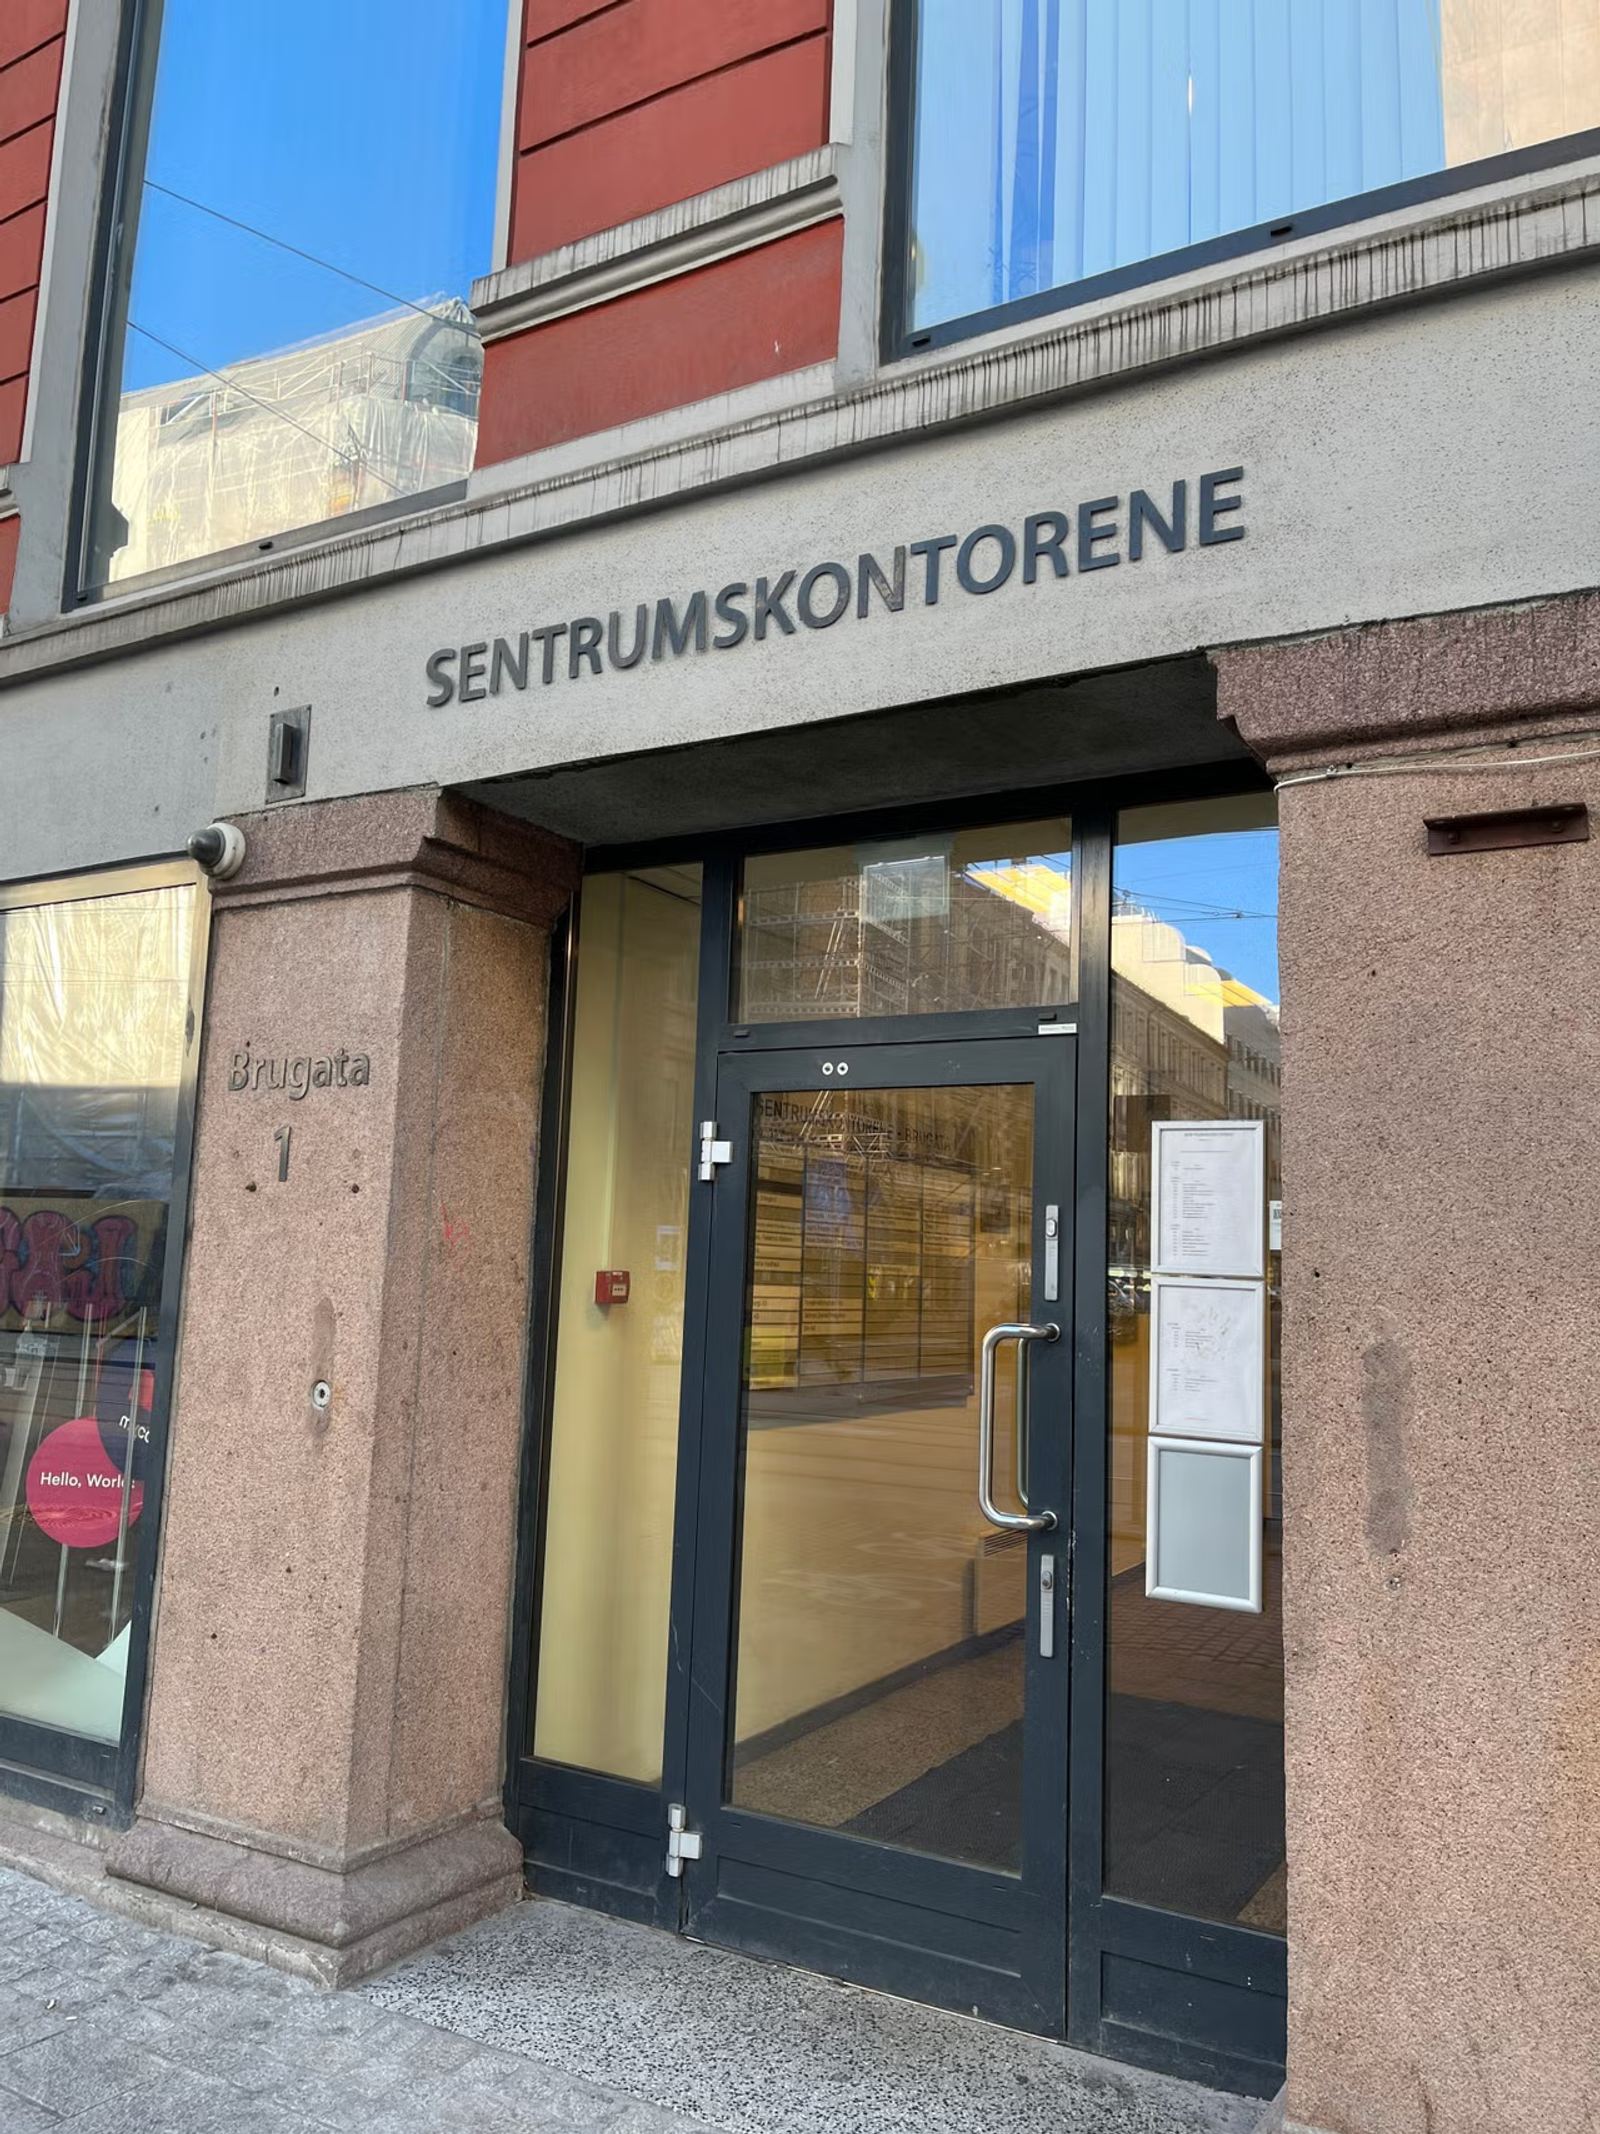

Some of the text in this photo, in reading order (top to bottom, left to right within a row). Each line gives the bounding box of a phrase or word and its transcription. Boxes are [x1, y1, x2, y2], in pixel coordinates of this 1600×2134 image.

[426, 466, 1244, 707] SENTRUMSKONTORENE
[228, 1050, 370, 1101] Brugata
[273, 1126, 292, 1182] 1
[40, 1472, 81, 1488] Hello,
